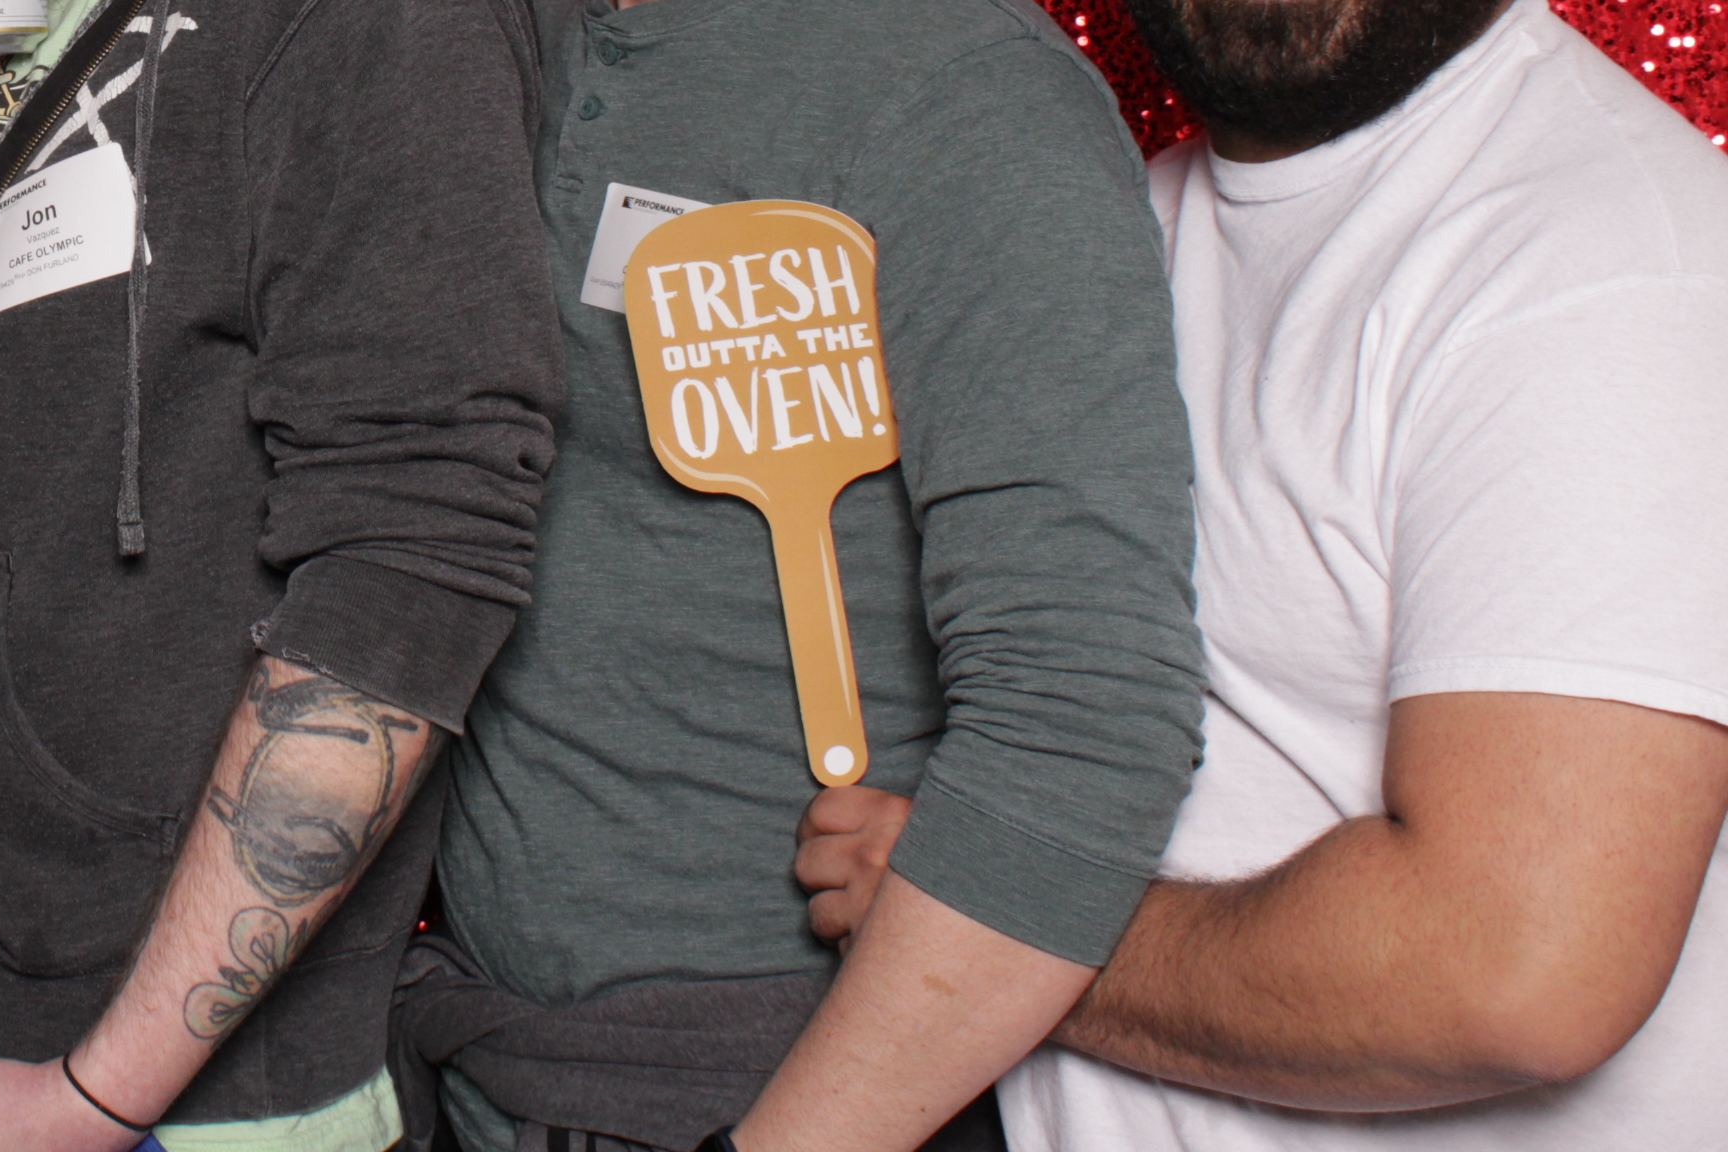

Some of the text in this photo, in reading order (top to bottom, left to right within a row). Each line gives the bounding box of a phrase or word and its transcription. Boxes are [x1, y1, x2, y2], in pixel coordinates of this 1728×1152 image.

[21, 203, 58, 232] Jon
[8, 234, 84, 269] CAFE OLYMPIC
[26, 226, 60, 245] Vazquez
[26, 264, 43, 277] DON
[43, 253, 80, 270] FURLANO
[646, 244, 860, 338] FRESH
[661, 322, 874, 372] OUTTA THE
[670, 354, 887, 460] OVEN!
